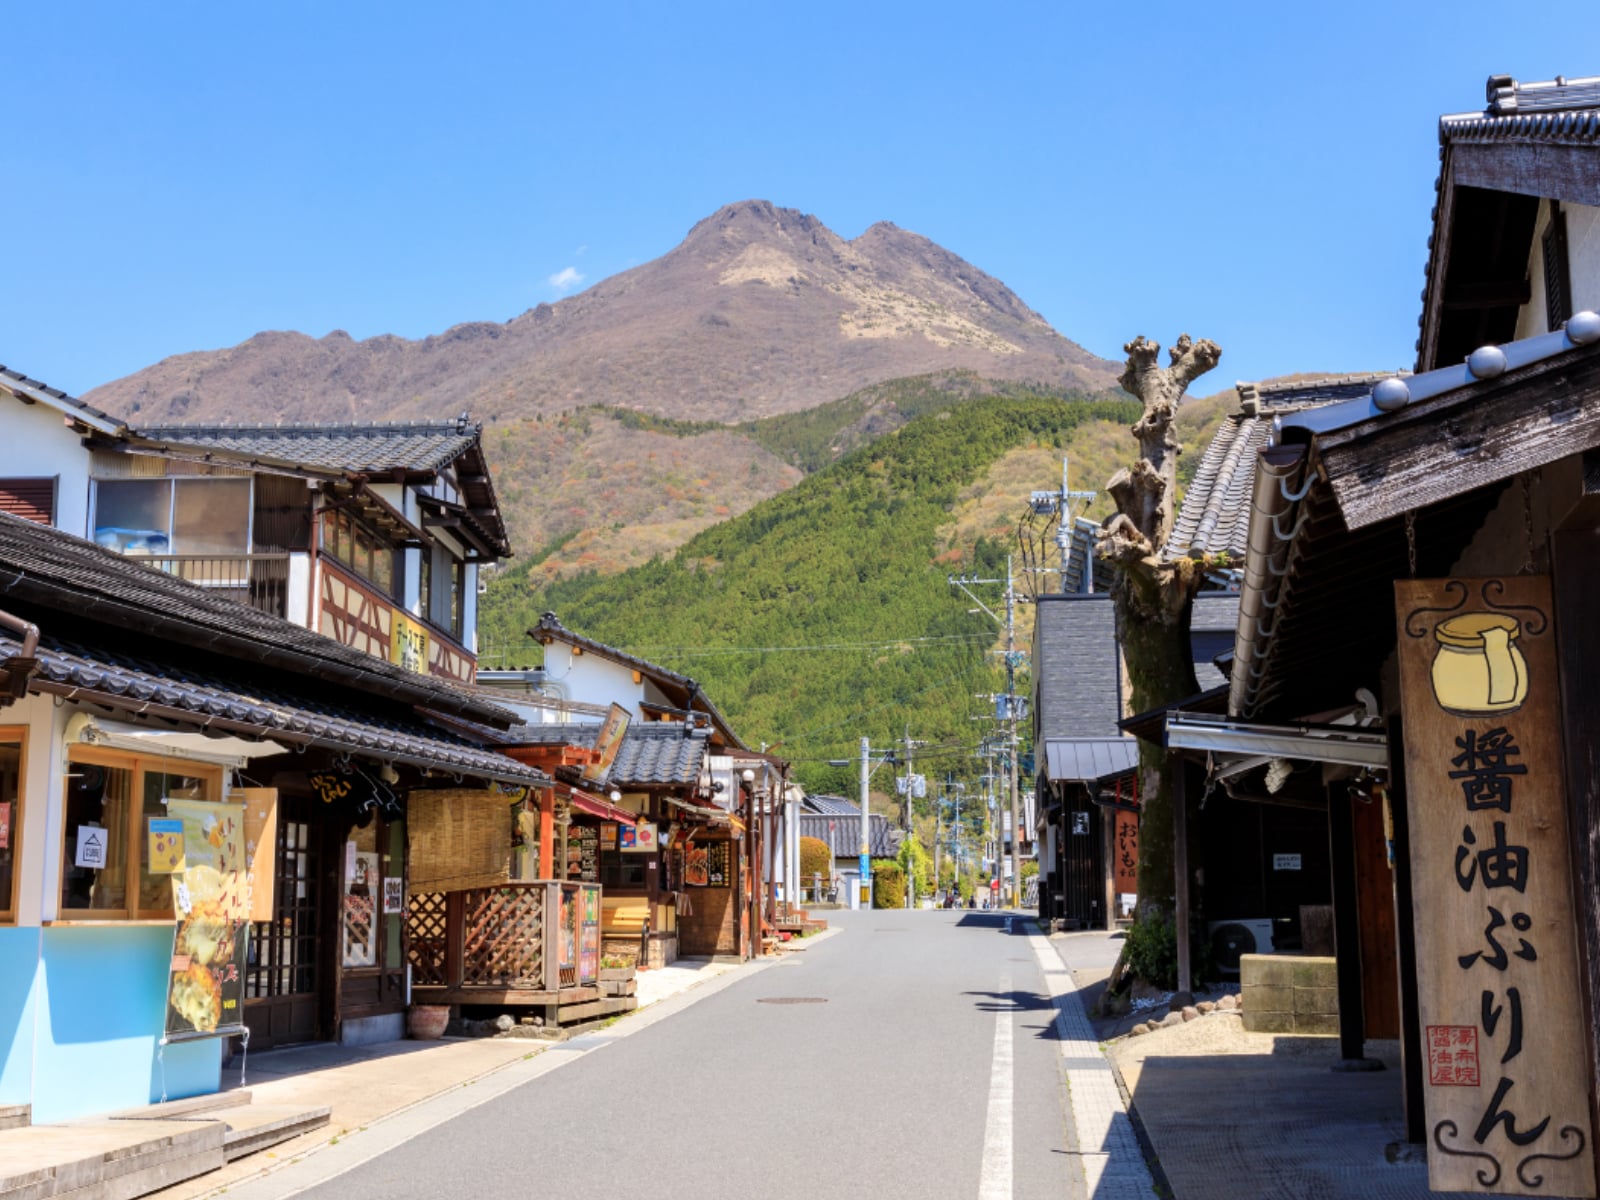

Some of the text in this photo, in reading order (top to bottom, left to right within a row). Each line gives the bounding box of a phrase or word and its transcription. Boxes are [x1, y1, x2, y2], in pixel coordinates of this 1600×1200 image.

[1119, 822, 1137, 867] おいも
[1448, 727, 1551, 1146] 醤油ぷりん
